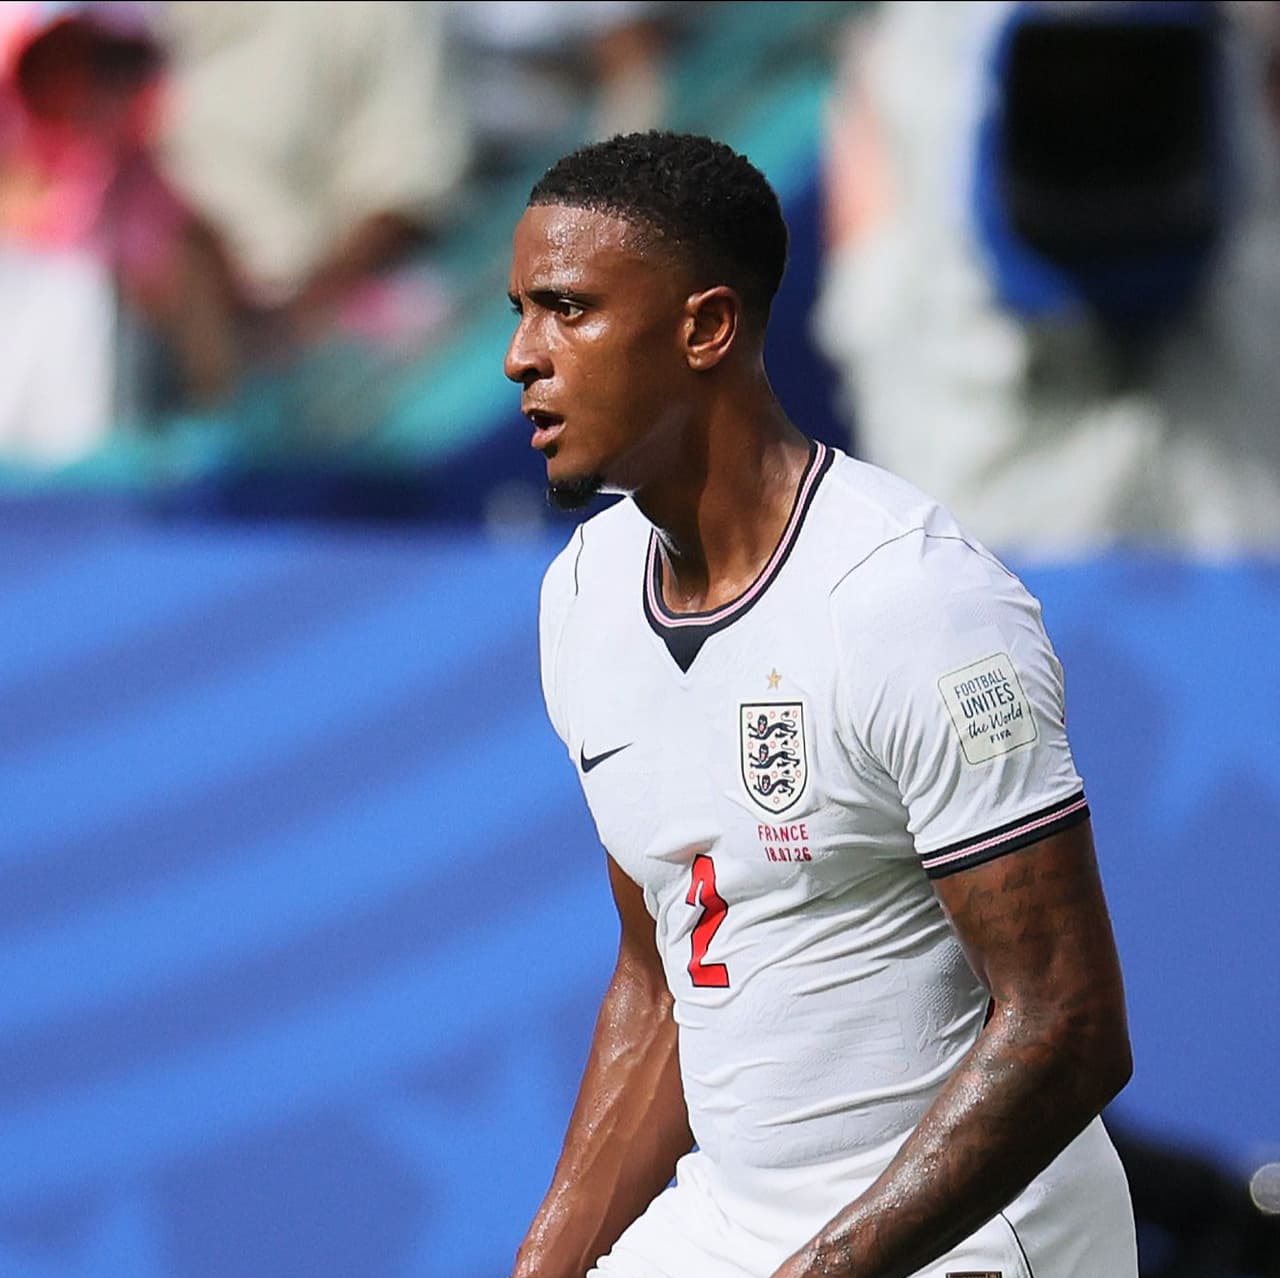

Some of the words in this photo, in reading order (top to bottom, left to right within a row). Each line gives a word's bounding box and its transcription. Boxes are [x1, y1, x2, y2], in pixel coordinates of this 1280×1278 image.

[954, 668, 1007, 699] FOOTBALL
[961, 682, 1015, 719] UNITES
[968, 720, 989, 739] the
[989, 702, 1023, 729] World
[990, 729, 1012, 743] FIFA
[758, 824, 808, 842] FRANCE
[686, 853, 730, 988] 2
